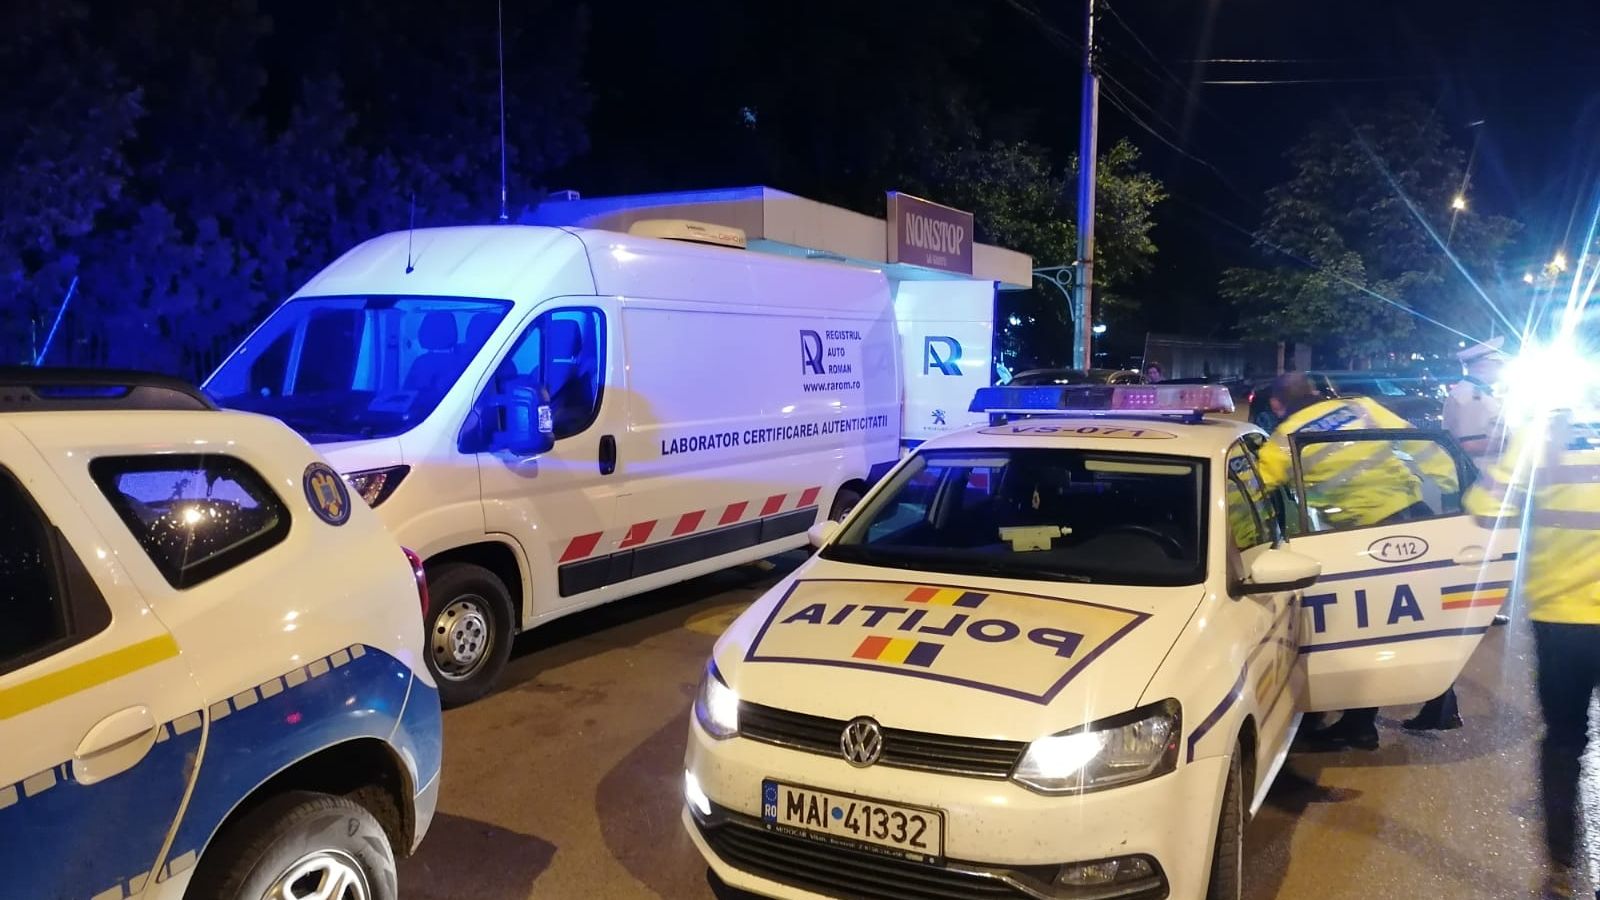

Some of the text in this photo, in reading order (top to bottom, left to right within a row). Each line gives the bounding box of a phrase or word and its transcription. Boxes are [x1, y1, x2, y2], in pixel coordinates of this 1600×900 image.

[905, 212, 964, 256] NONSTOP
[825, 330, 862, 340] REGISTRUL
[827, 347, 845, 357] AUTO
[828, 364, 852, 374] ROMAN
[803, 380, 861, 392] www.rarom.ro
[661, 415, 888, 456] LABORATOR CERTIFICAREA AUTENTICITATII
[1012, 426, 1145, 437] VS-071
[1395, 542, 1417, 556] 112
[764, 802, 777, 818] RO
[786, 790, 829, 829] MAI
[844, 802, 928, 849] 41332
